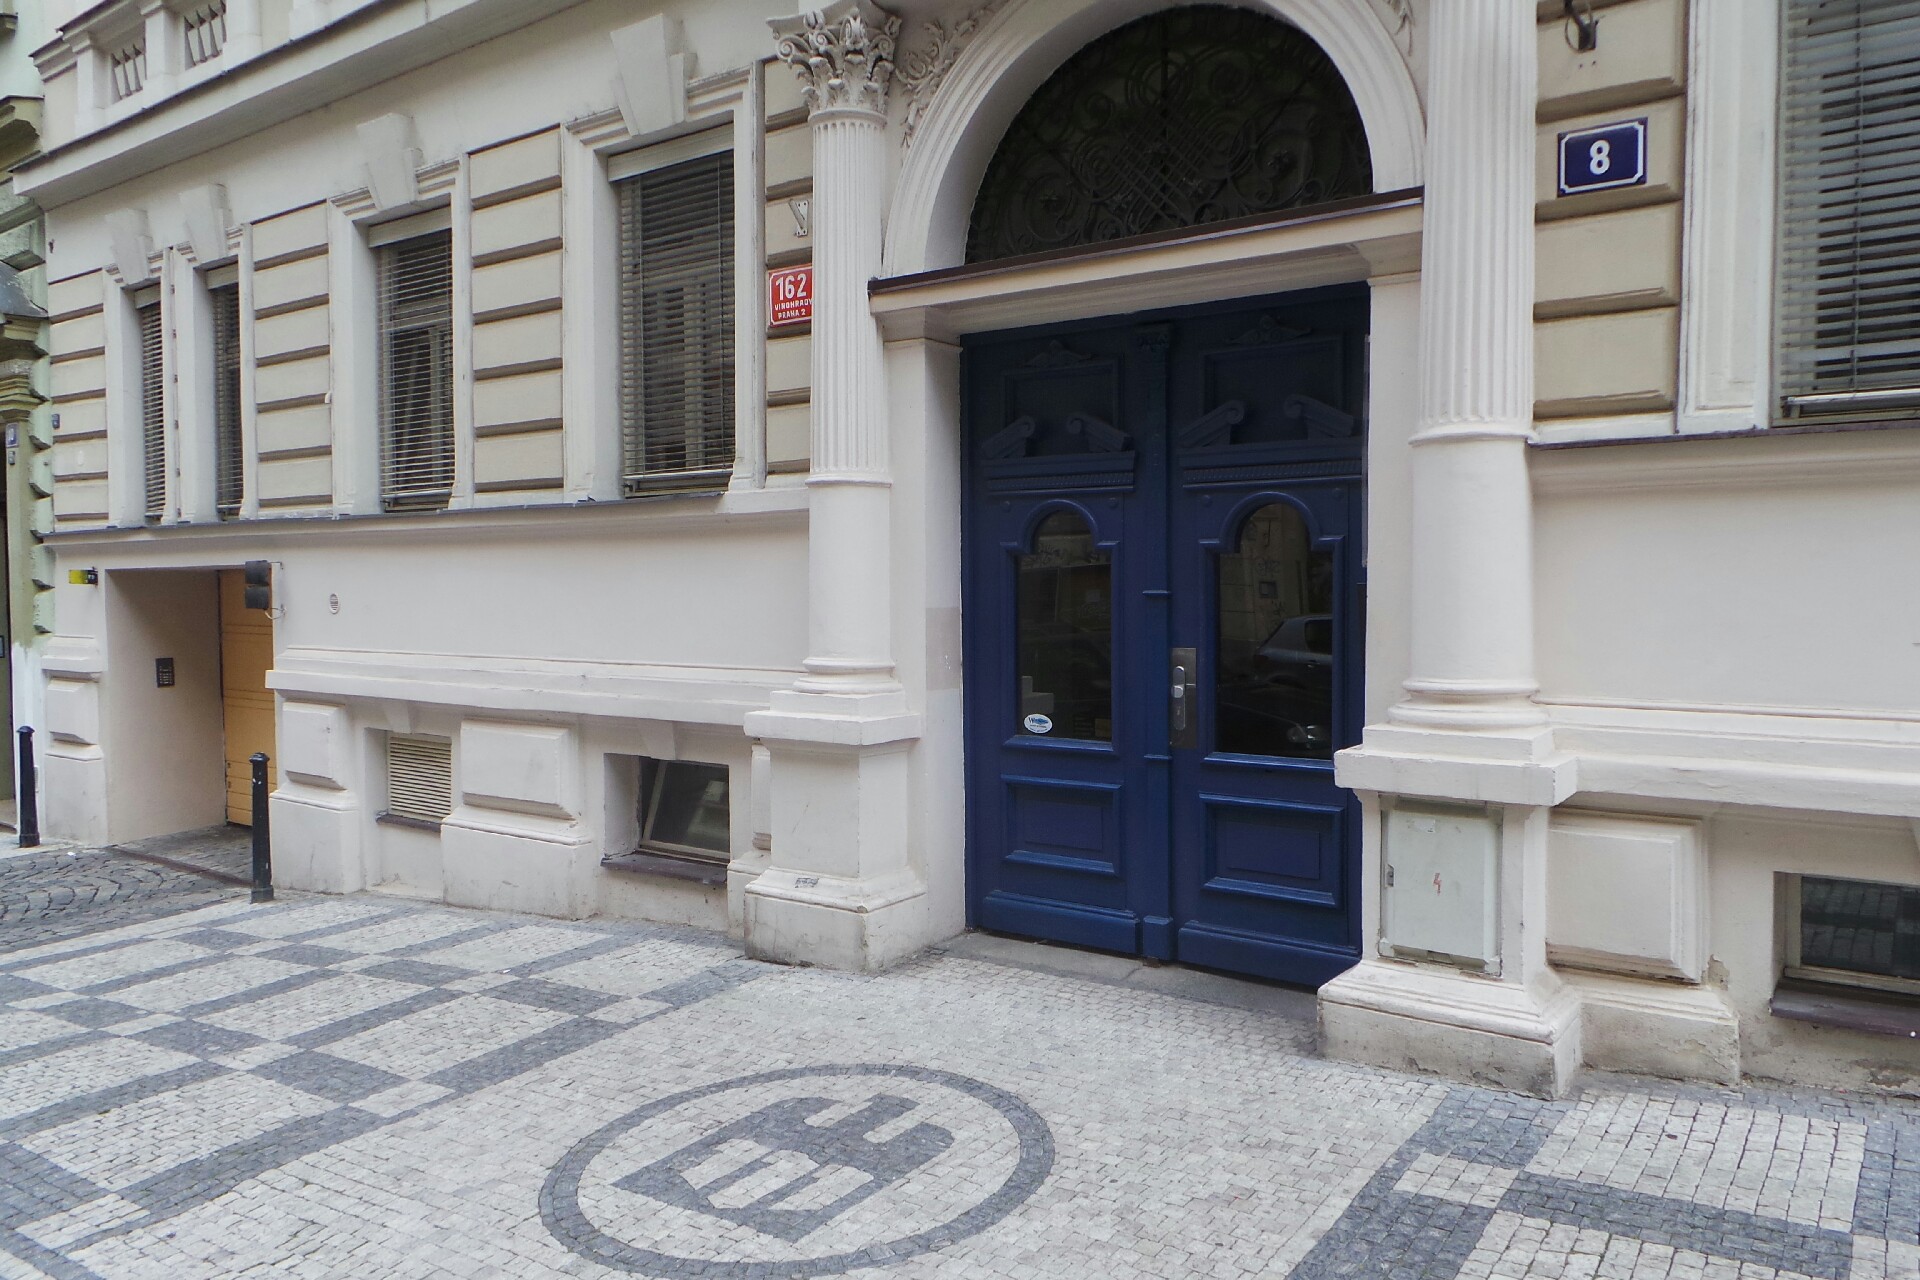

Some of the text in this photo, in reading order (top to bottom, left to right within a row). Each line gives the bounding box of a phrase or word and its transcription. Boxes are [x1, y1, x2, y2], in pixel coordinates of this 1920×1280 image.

[1589, 139, 1610, 175] 8
[775, 273, 806, 300] 162
[774, 298, 812, 310] VINOHRADY
[778, 309, 800, 319] PRAHA
